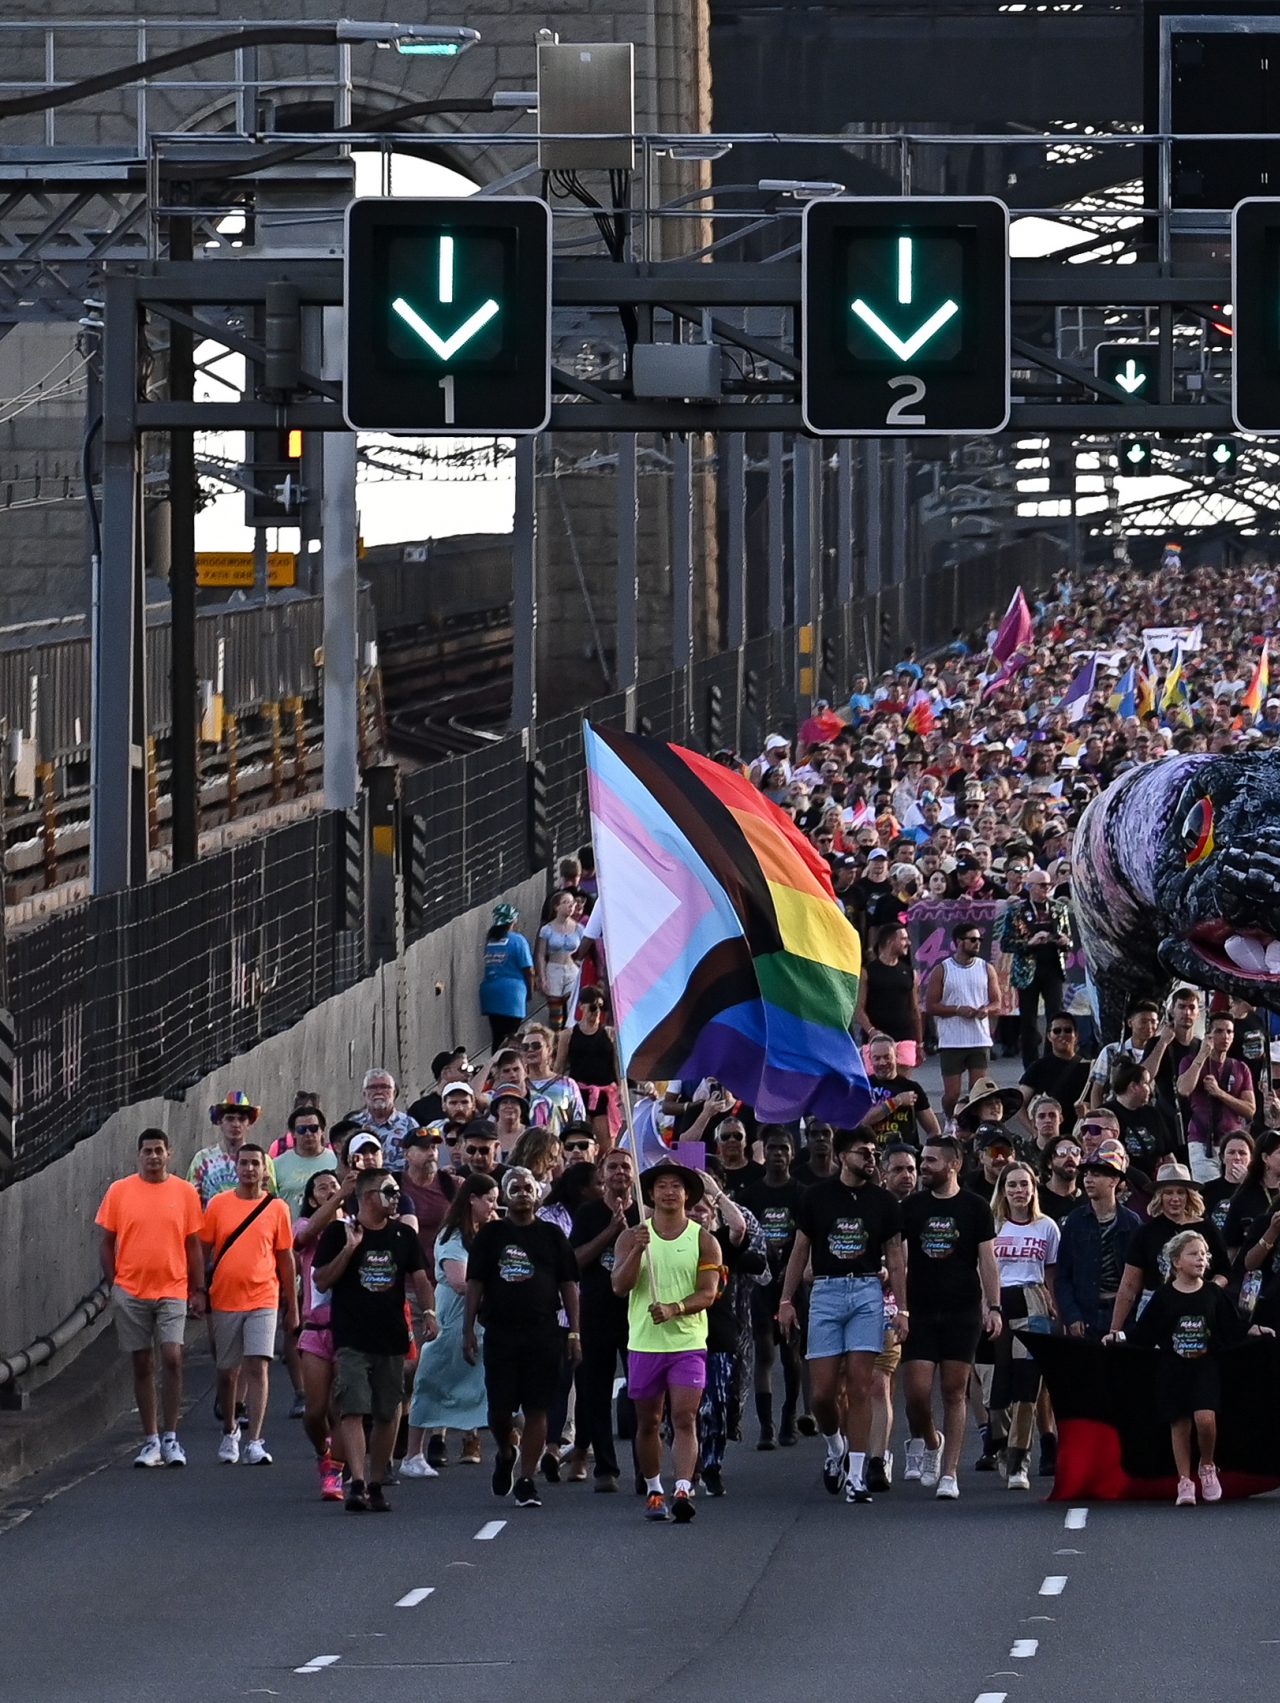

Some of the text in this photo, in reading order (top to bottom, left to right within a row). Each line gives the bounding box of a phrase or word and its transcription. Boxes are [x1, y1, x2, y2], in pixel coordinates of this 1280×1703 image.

[439, 376, 455, 424] 1
[886, 376, 927, 425] 2
[1024, 1237, 1048, 1249] THE
